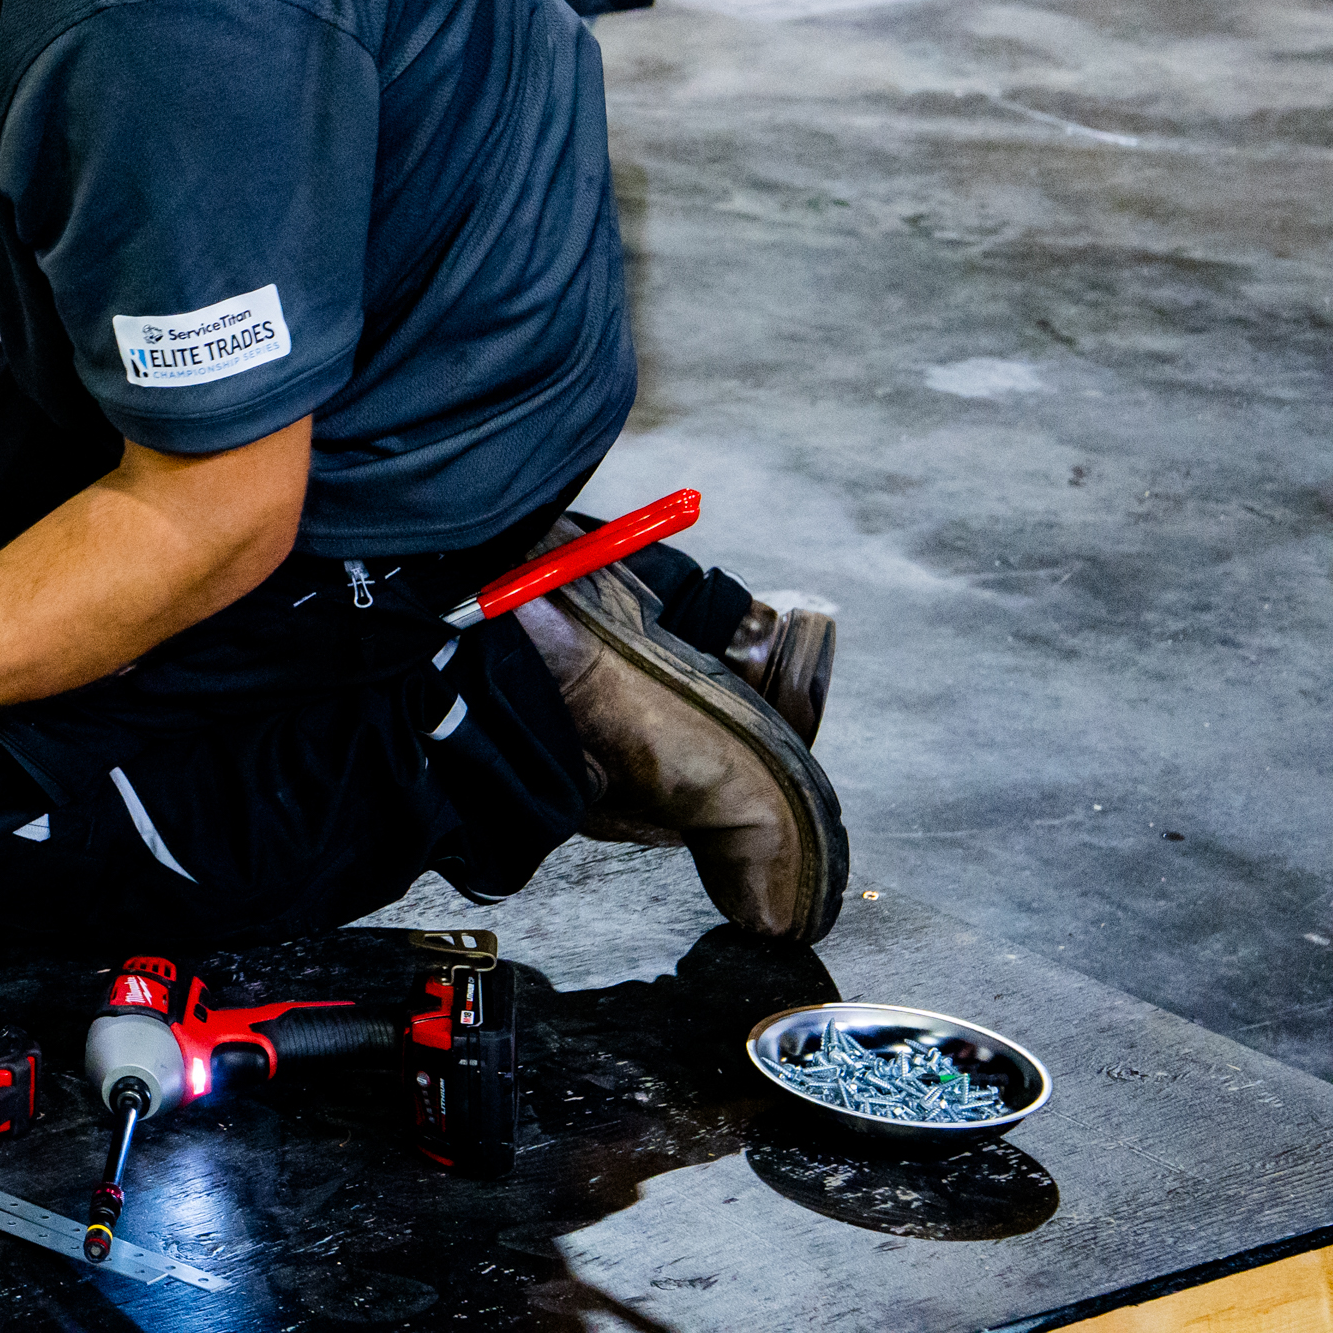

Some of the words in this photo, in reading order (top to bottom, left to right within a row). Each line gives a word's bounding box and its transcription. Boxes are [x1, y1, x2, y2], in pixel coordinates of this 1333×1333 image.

[149, 345, 203, 368] ELITE
[204, 320, 275, 361] TRADES
[168, 309, 252, 341] ServiceTitan
[153, 356, 240, 380] CHAMPIONSHIP
[242, 341, 281, 362] SERIES
